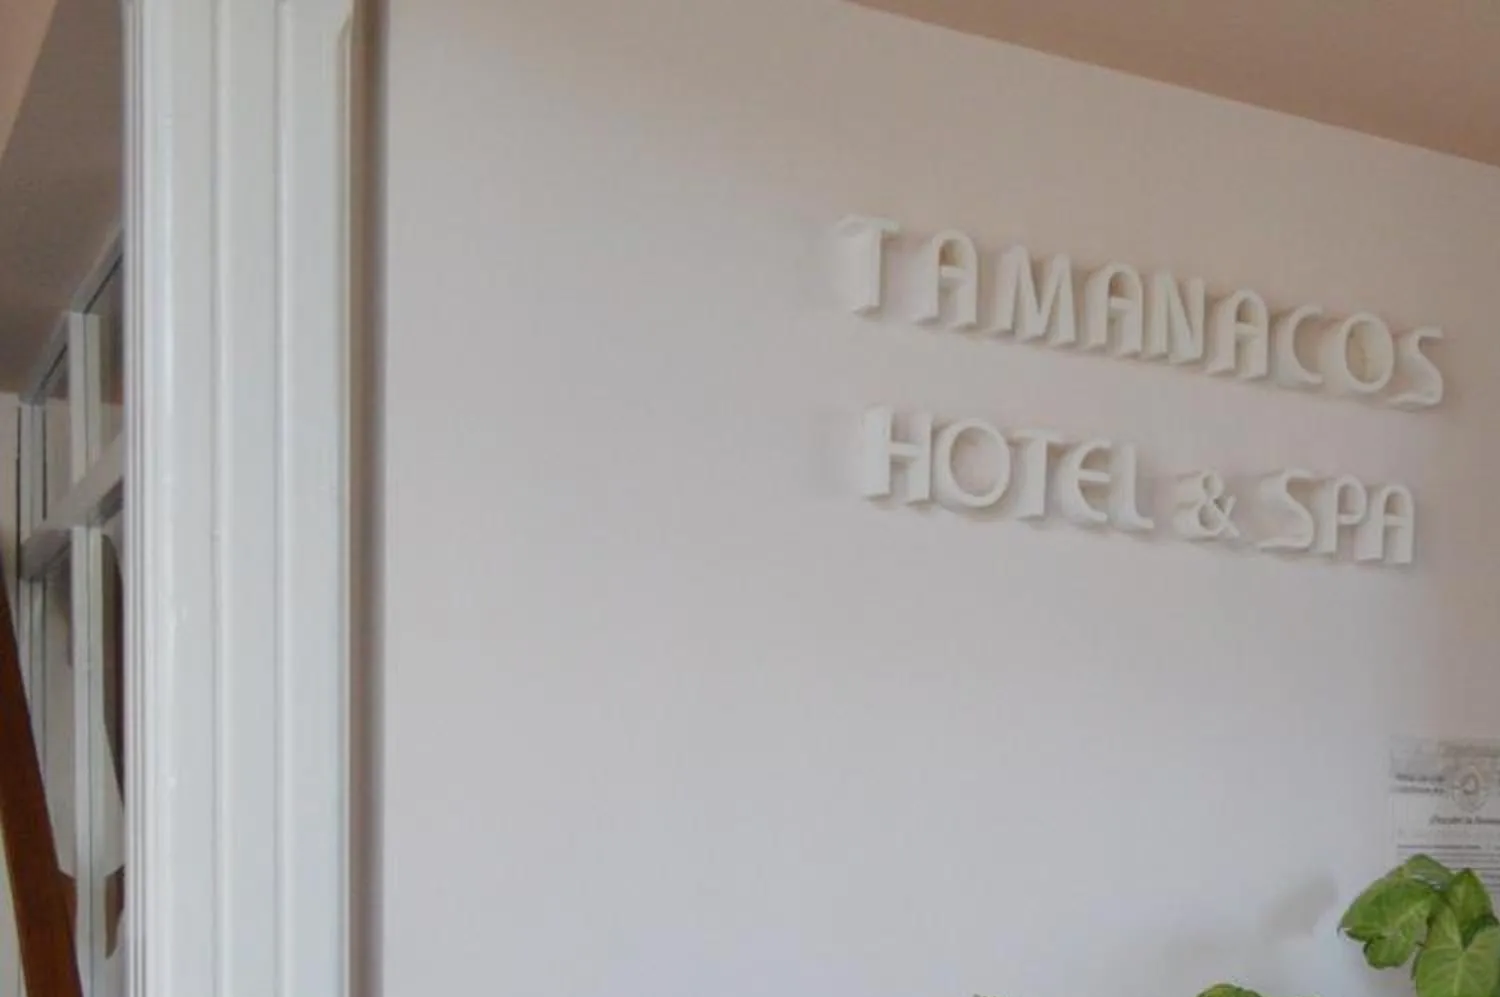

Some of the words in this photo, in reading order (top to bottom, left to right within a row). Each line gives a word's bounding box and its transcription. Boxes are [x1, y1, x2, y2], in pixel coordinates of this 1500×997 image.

[835, 213, 1444, 408] TAMANACOS
[862, 406, 1155, 529] HOTEL
[1178, 467, 1240, 541] &
[1258, 468, 1416, 565] SPA
